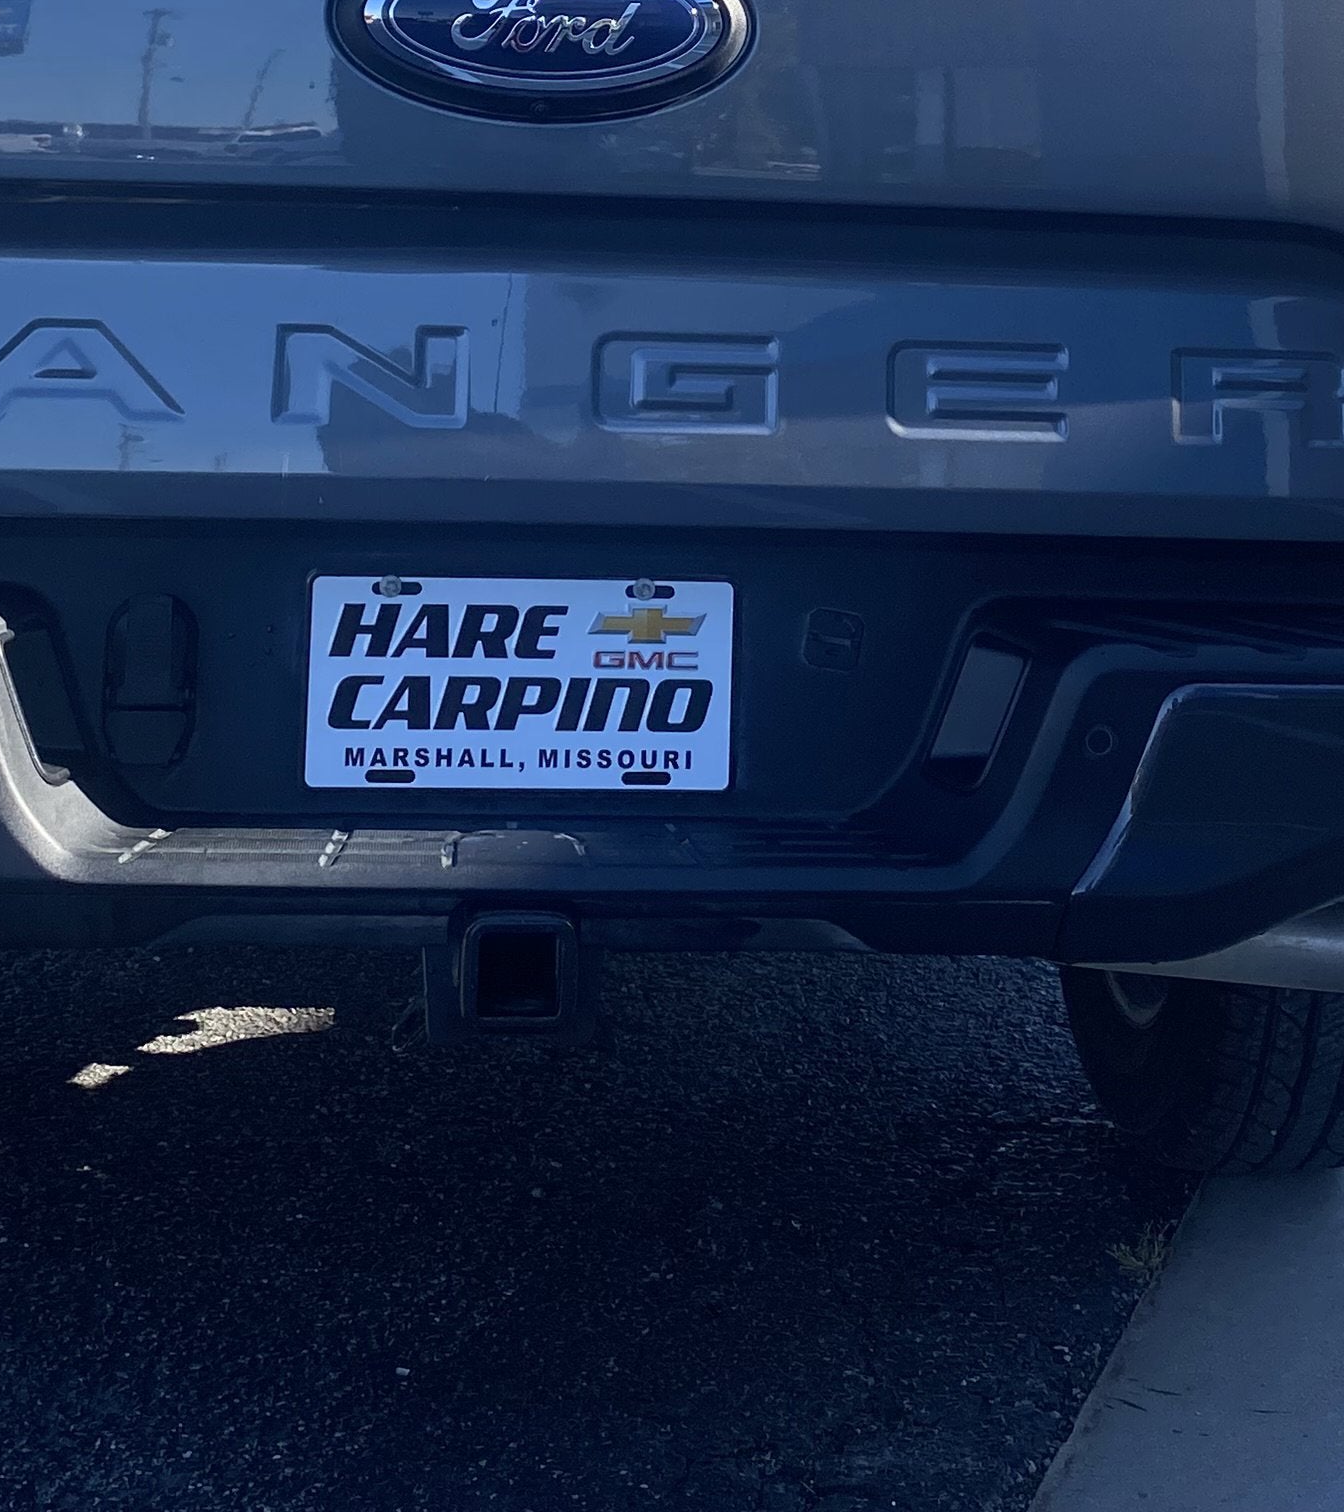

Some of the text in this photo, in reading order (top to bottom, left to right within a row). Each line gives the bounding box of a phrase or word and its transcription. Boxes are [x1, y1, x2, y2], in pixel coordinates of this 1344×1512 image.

[327, 603, 570, 659] HARE
[592, 650, 699, 671] GMC
[327, 675, 714, 733] CARPINO
[344, 747, 693, 772] MARSHALL, MISSOURI
